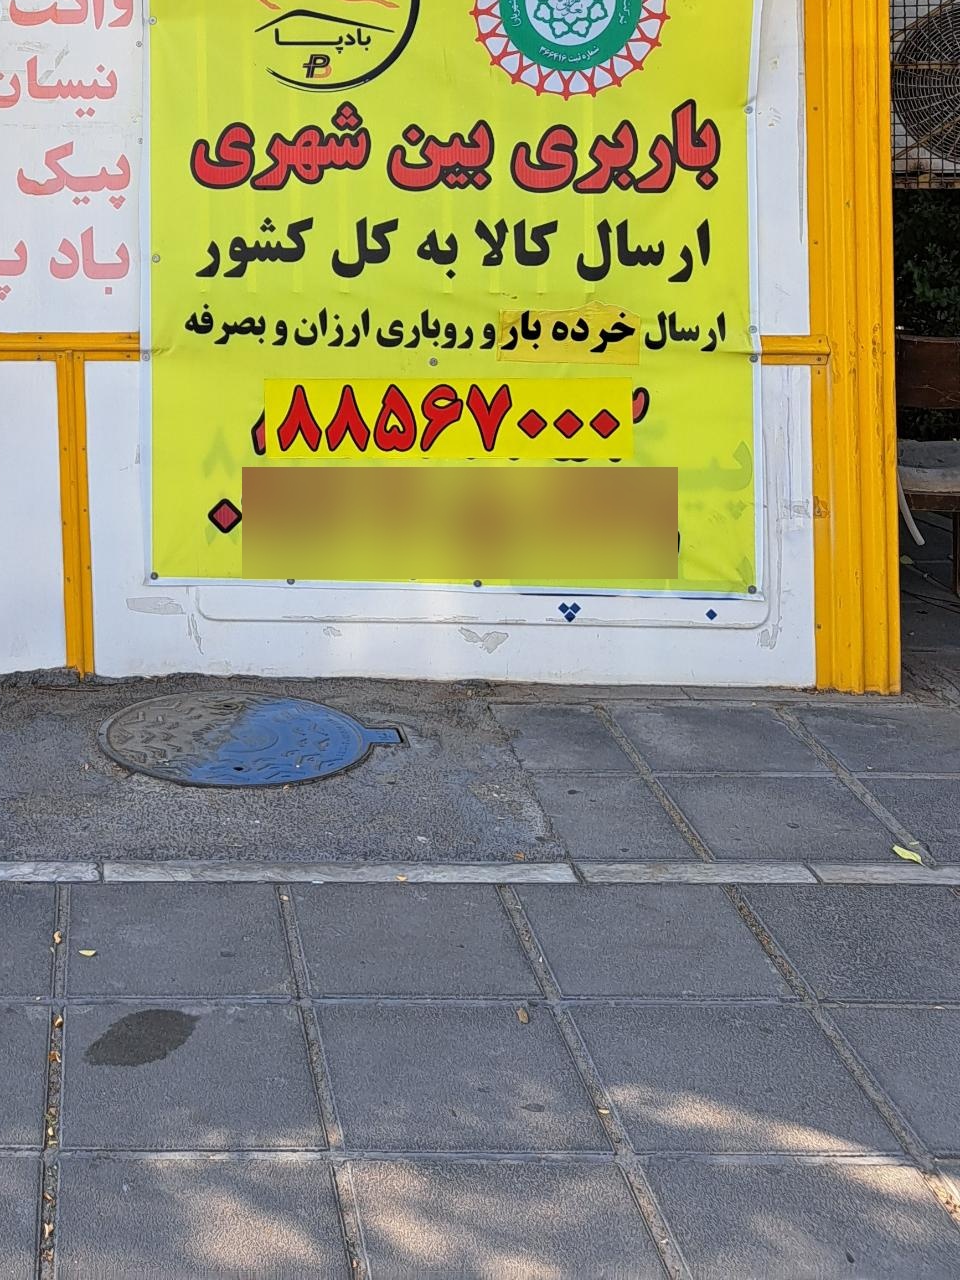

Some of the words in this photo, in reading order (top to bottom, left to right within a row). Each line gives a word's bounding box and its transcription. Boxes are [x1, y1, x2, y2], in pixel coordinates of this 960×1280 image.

[190, 100, 371, 192] شهری
[386, 118, 495, 192] بین
[510, 98, 722, 193] باربری
[16, 140, 131, 210] پیک
[49, 225, 130, 296] باد
[196, 217, 314, 278] کشور
[332, 217, 398, 278] کل
[416, 230, 458, 279] به
[475, 218, 558, 266] کالا
[577, 219, 710, 282] ارسال
[184, 303, 266, 345] بصرفه
[271, 320, 288, 345] و
[294, 307, 370, 347] ارزان
[479, 322, 496, 350] و
[500, 309, 541, 351] بار
[552, 318, 635, 352] خرده
[644, 311, 727, 352] ارسال
[276, 384, 621, 453] ۸۸۵۶۷۰۰۰
